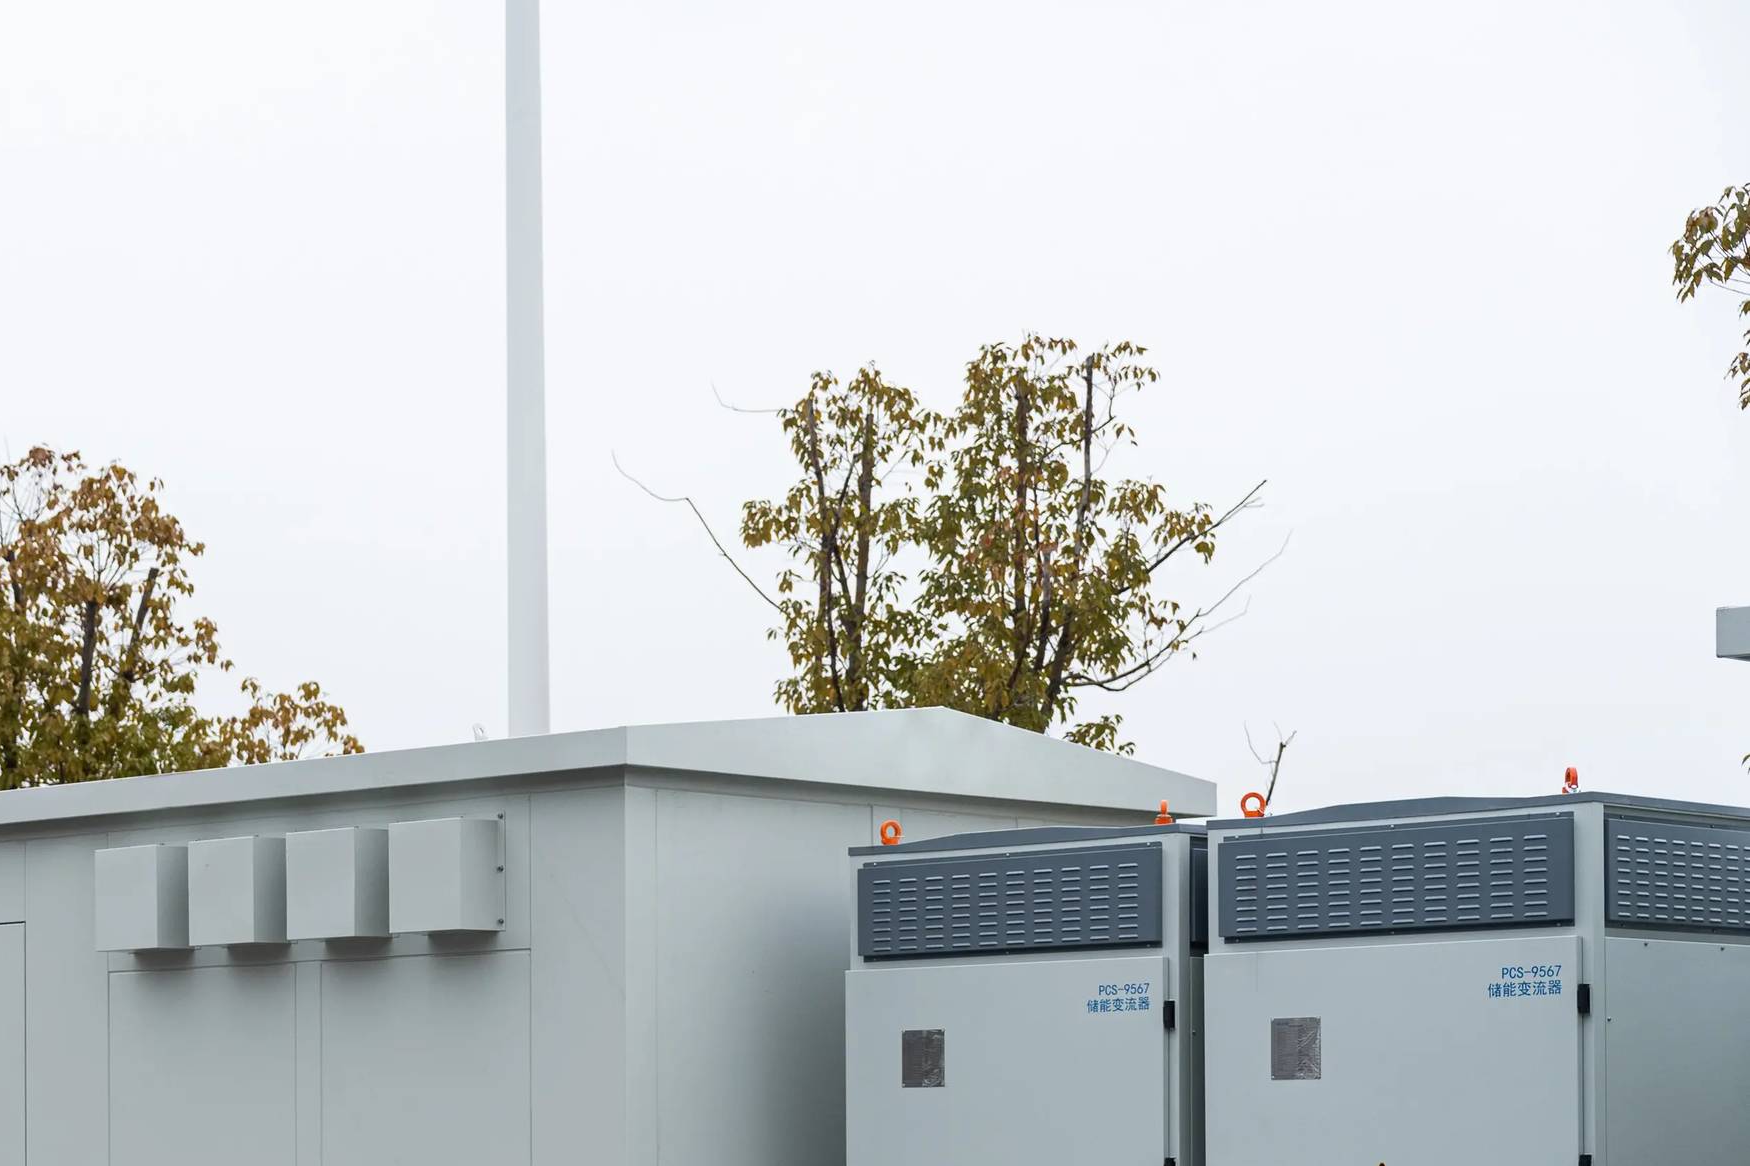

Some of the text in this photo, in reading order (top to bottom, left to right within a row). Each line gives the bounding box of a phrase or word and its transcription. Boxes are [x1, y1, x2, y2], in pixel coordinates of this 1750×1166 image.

[1501, 965, 1562, 979] PCS-9567
[1098, 983, 1150, 996] PCS-9567
[1488, 980, 1562, 998] 储能变流器
[1087, 996, 1150, 1013] 储能变流器
